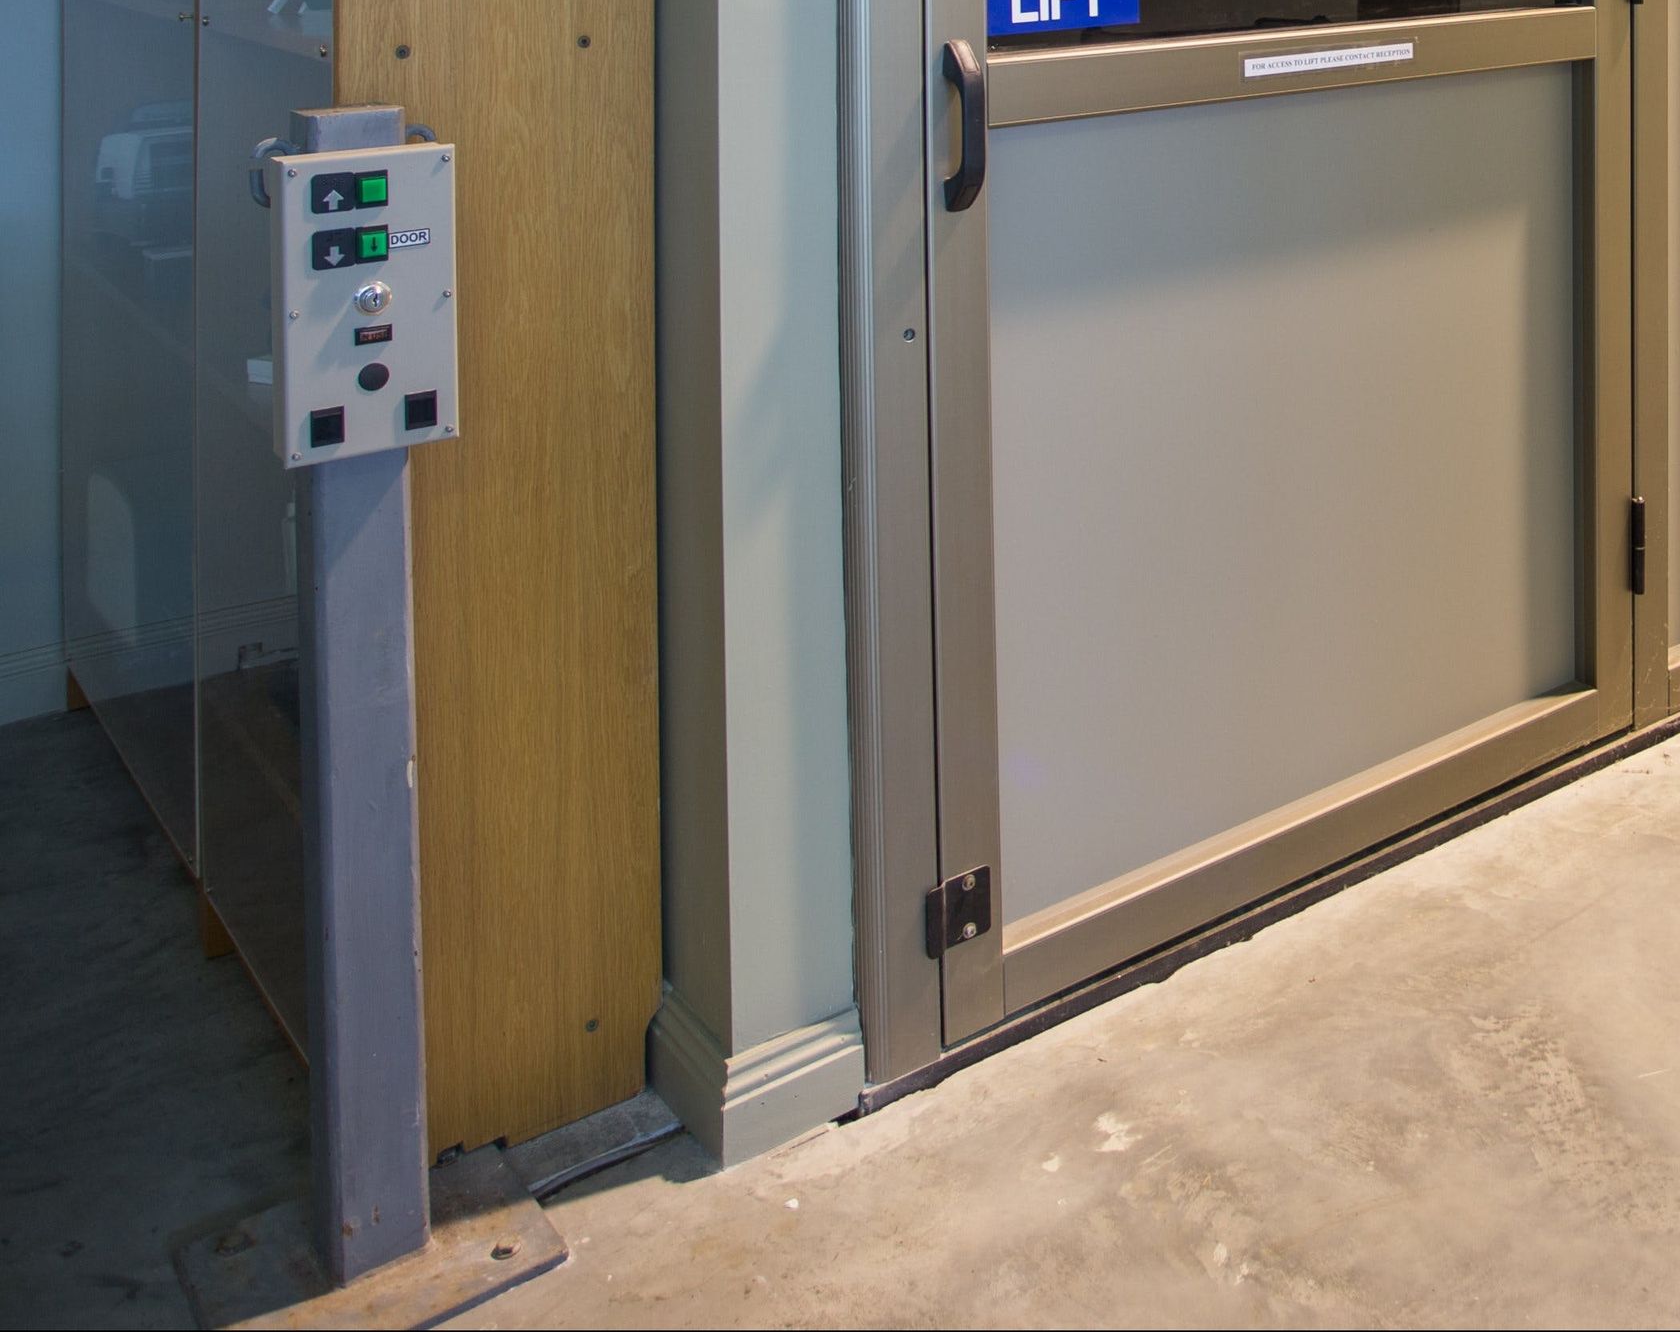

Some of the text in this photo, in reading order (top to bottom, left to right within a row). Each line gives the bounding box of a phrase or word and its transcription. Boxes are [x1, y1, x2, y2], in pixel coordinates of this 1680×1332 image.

[1267, 60, 1293, 69] ACCESS
[1294, 59, 1303, 67] TO
[1304, 57, 1318, 66] LIFT
[1320, 55, 1344, 64] PLEASE
[1345, 52, 1374, 61] CONTACT
[1375, 49, 1411, 58] RECEPTION
[390, 231, 428, 245] DOOR
